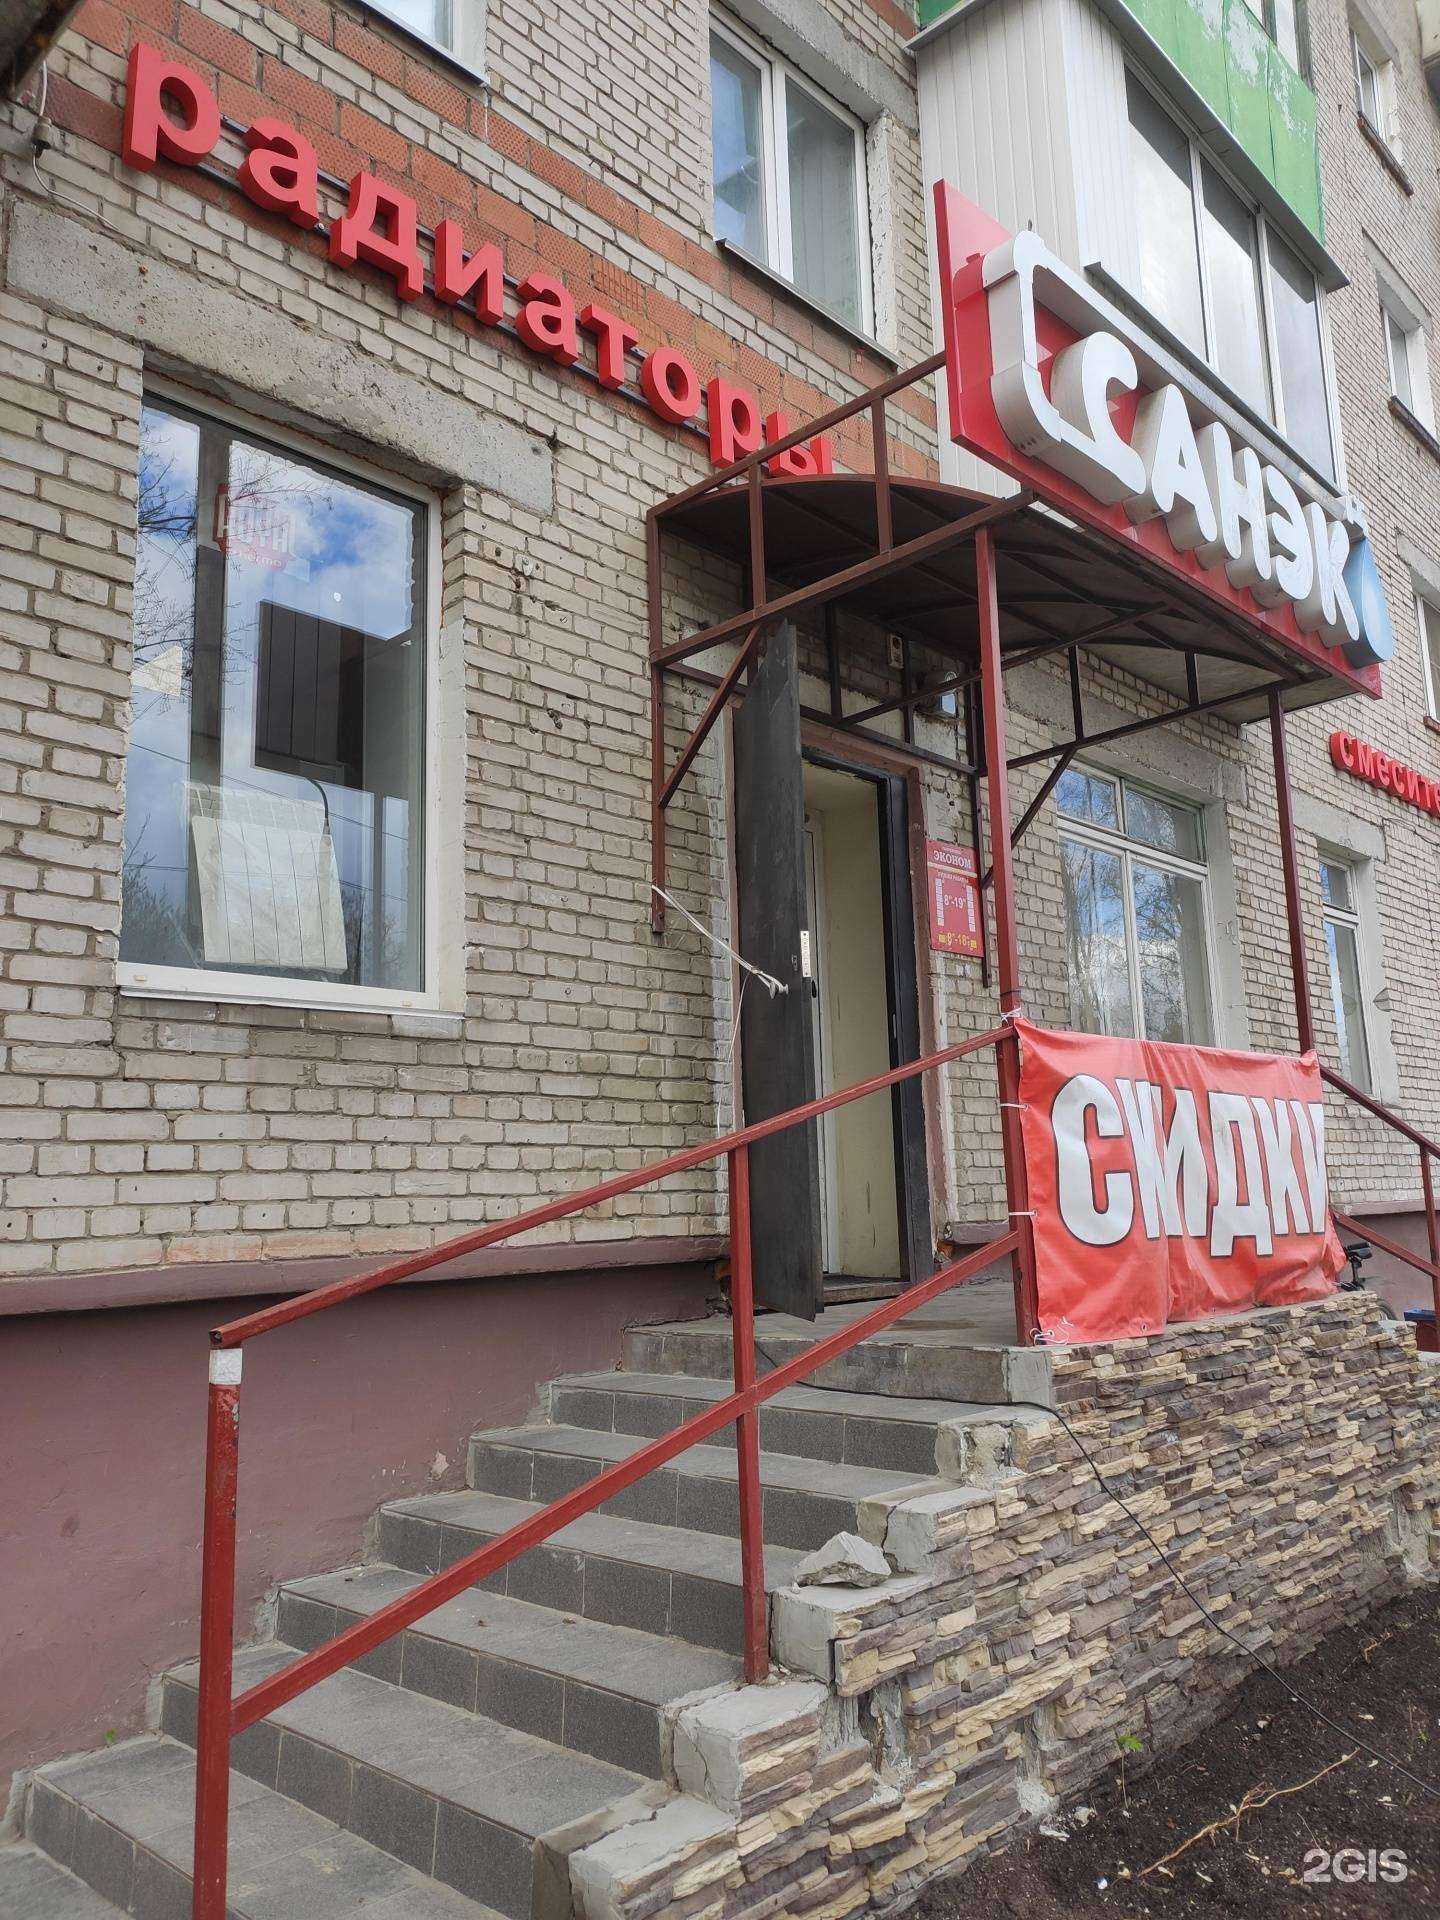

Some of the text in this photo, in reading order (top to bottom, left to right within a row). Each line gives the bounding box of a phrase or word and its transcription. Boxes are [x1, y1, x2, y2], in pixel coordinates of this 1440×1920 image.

[122, 42, 833, 478] радиаторы
[933, 850, 972, 869] ЭКОНОМ
[1051, 1074, 1326, 1258] СКИДКИ
